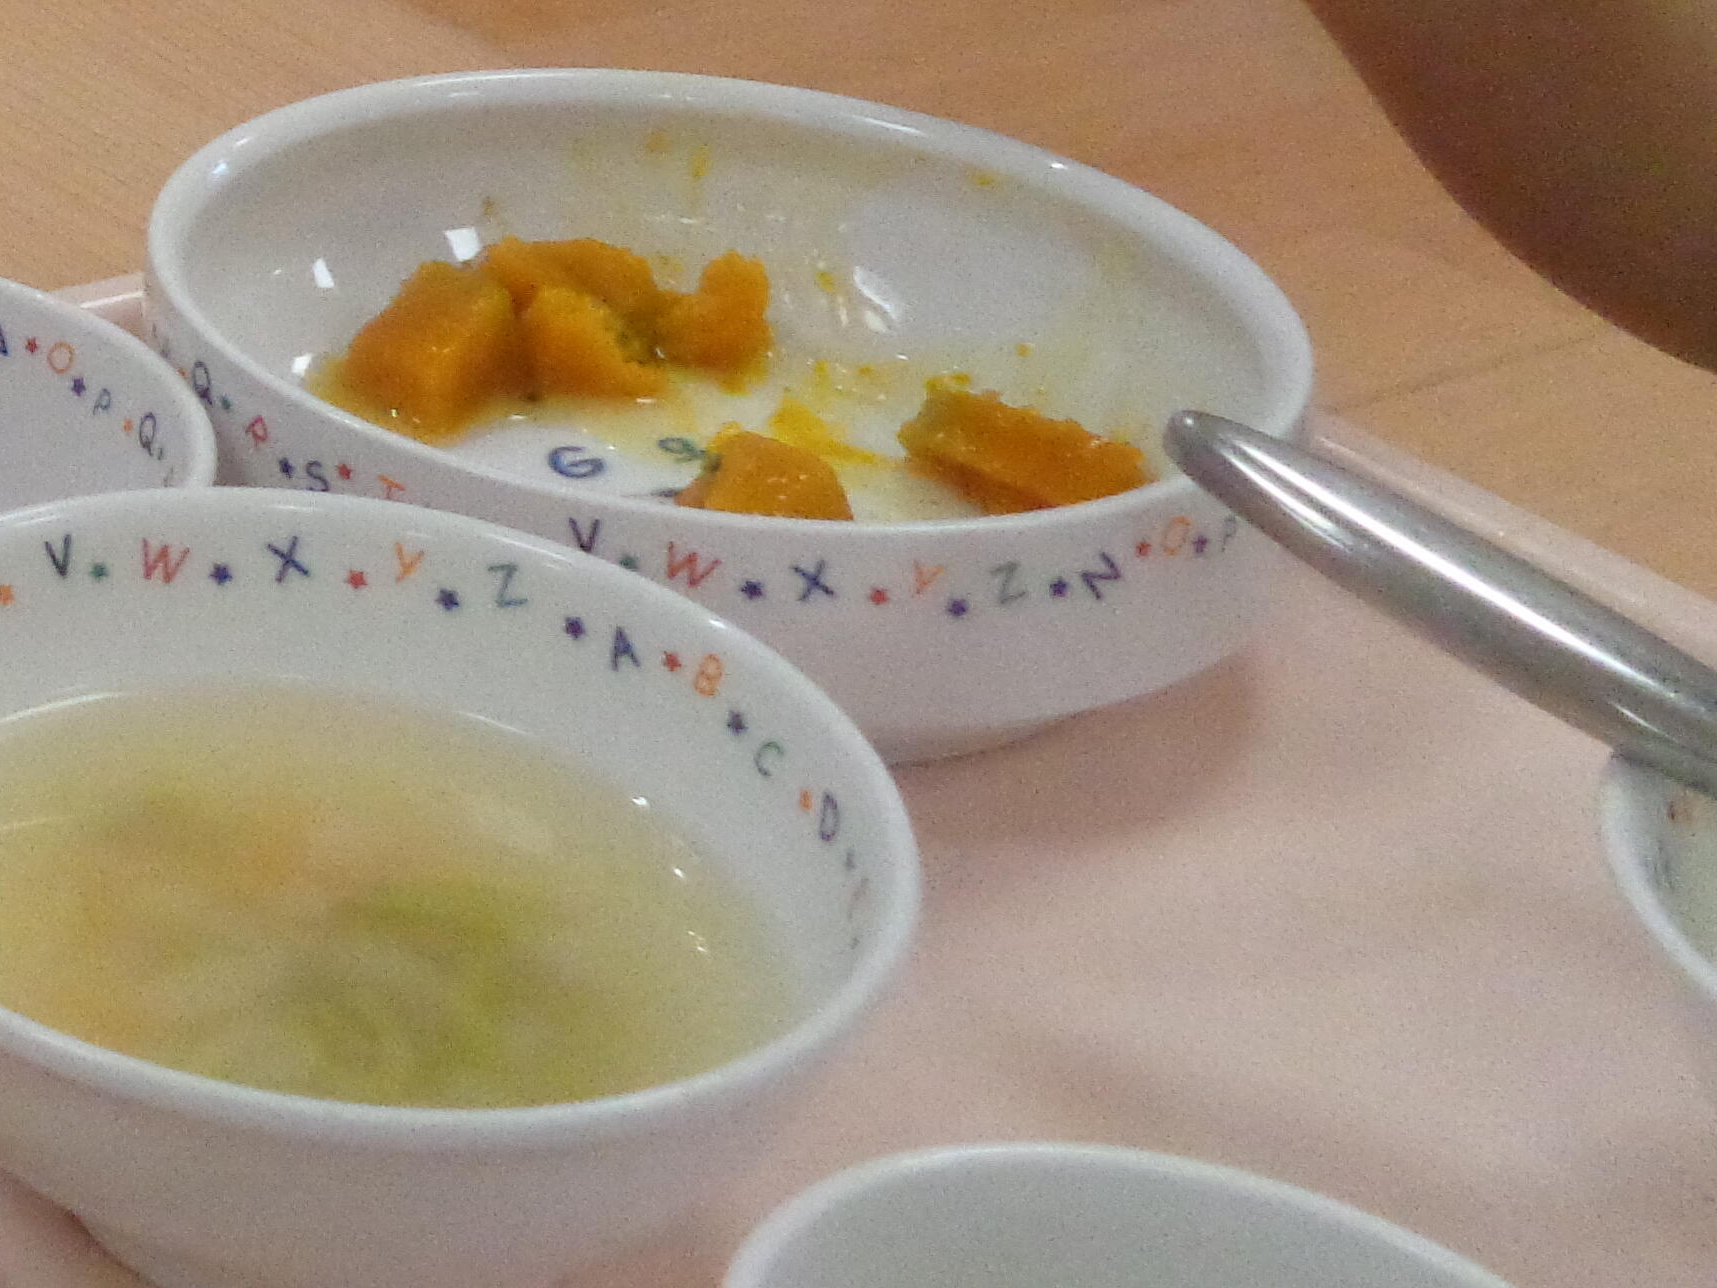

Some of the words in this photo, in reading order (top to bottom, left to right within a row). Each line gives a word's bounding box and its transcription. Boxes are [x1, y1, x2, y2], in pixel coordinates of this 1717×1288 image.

[48, 341, 73, 374] O
[94, 388, 112, 415] P
[139, 412, 156, 456] Q
[192, 360, 213, 406] Q
[245, 414, 268, 451] R
[305, 460, 329, 492] S
[377, 474, 406, 499] T
[569, 516, 600, 553] V
[665, 540, 723, 589] W
[791, 560, 835, 602] X
[914, 559, 945, 597] Y
[989, 560, 1025, 604] Z
[1081, 551, 1121, 601] N
[1164, 515, 1191, 556] O
[547, 445, 606, 479] G
[45, 533, 72, 579] V
[142, 537, 191, 584] W
[266, 535, 310, 584] X
[394, 541, 425, 584] Y
[487, 563, 528, 608] Z
[611, 625, 642, 671] A
[694, 652, 723, 698] B
[754, 740, 784, 779] C
[819, 786, 840, 843] D
